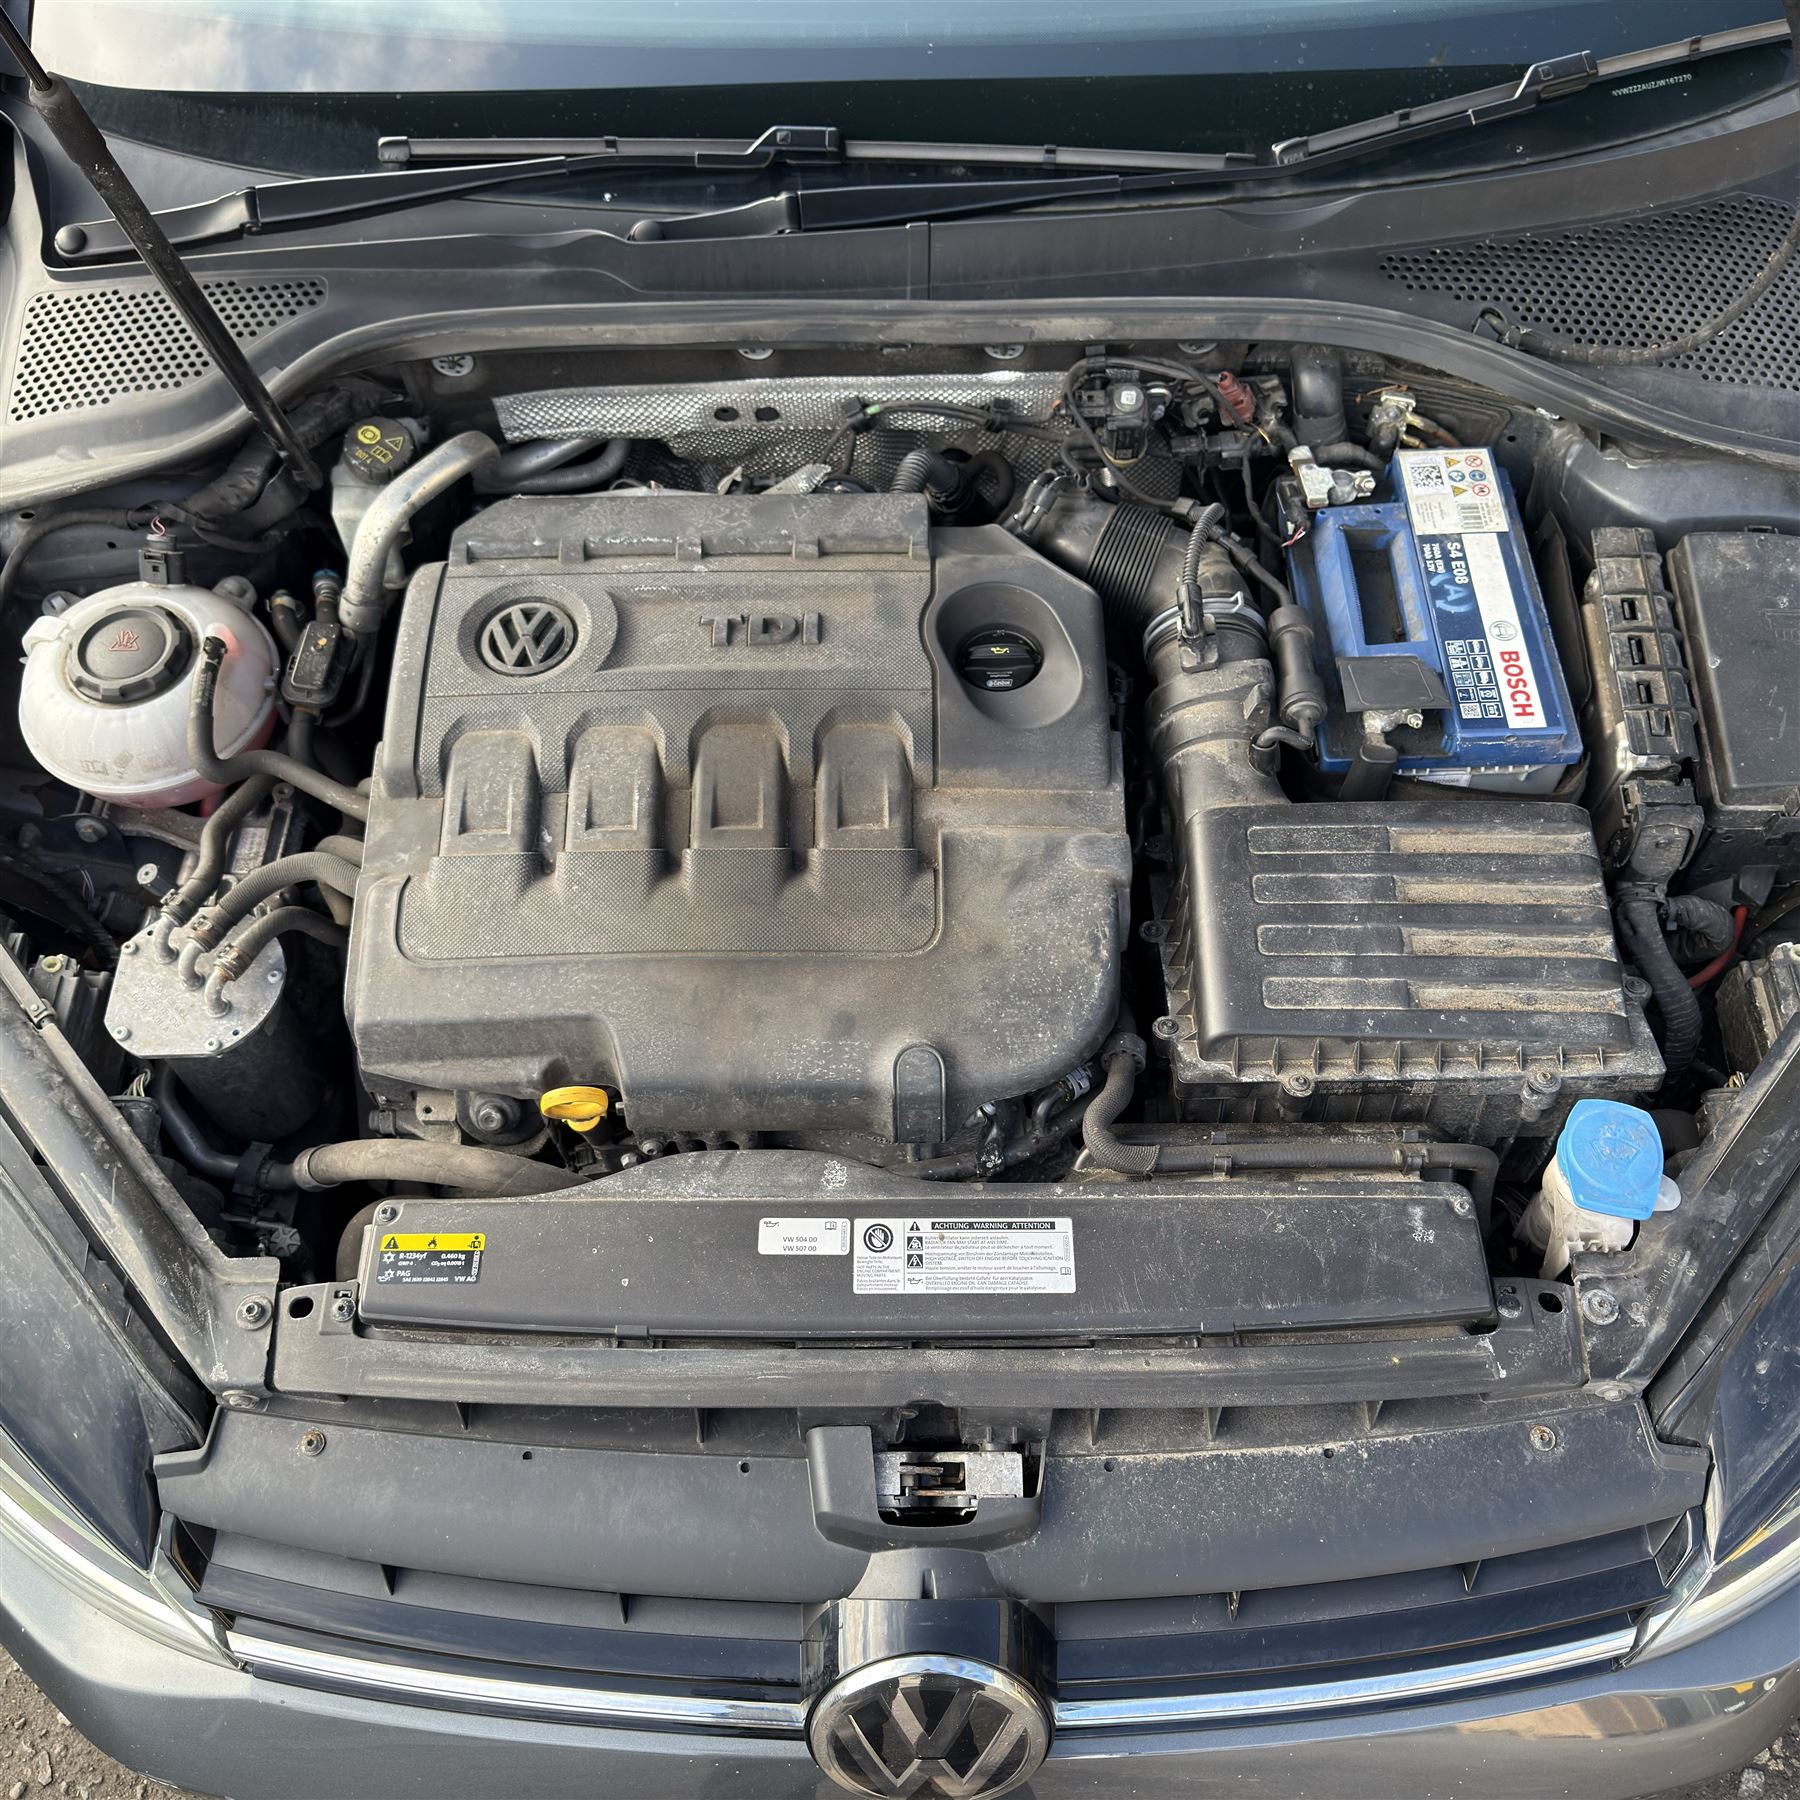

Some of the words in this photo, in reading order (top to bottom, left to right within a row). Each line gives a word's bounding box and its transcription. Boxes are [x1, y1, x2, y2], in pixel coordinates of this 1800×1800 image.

[1446, 541, 1464, 559] S4
[1450, 560, 1470, 585] E08
[700, 611, 822, 648] TDI
[1499, 650, 1535, 717] BOSCH
[399, 1252, 428, 1260] R-1234yf
